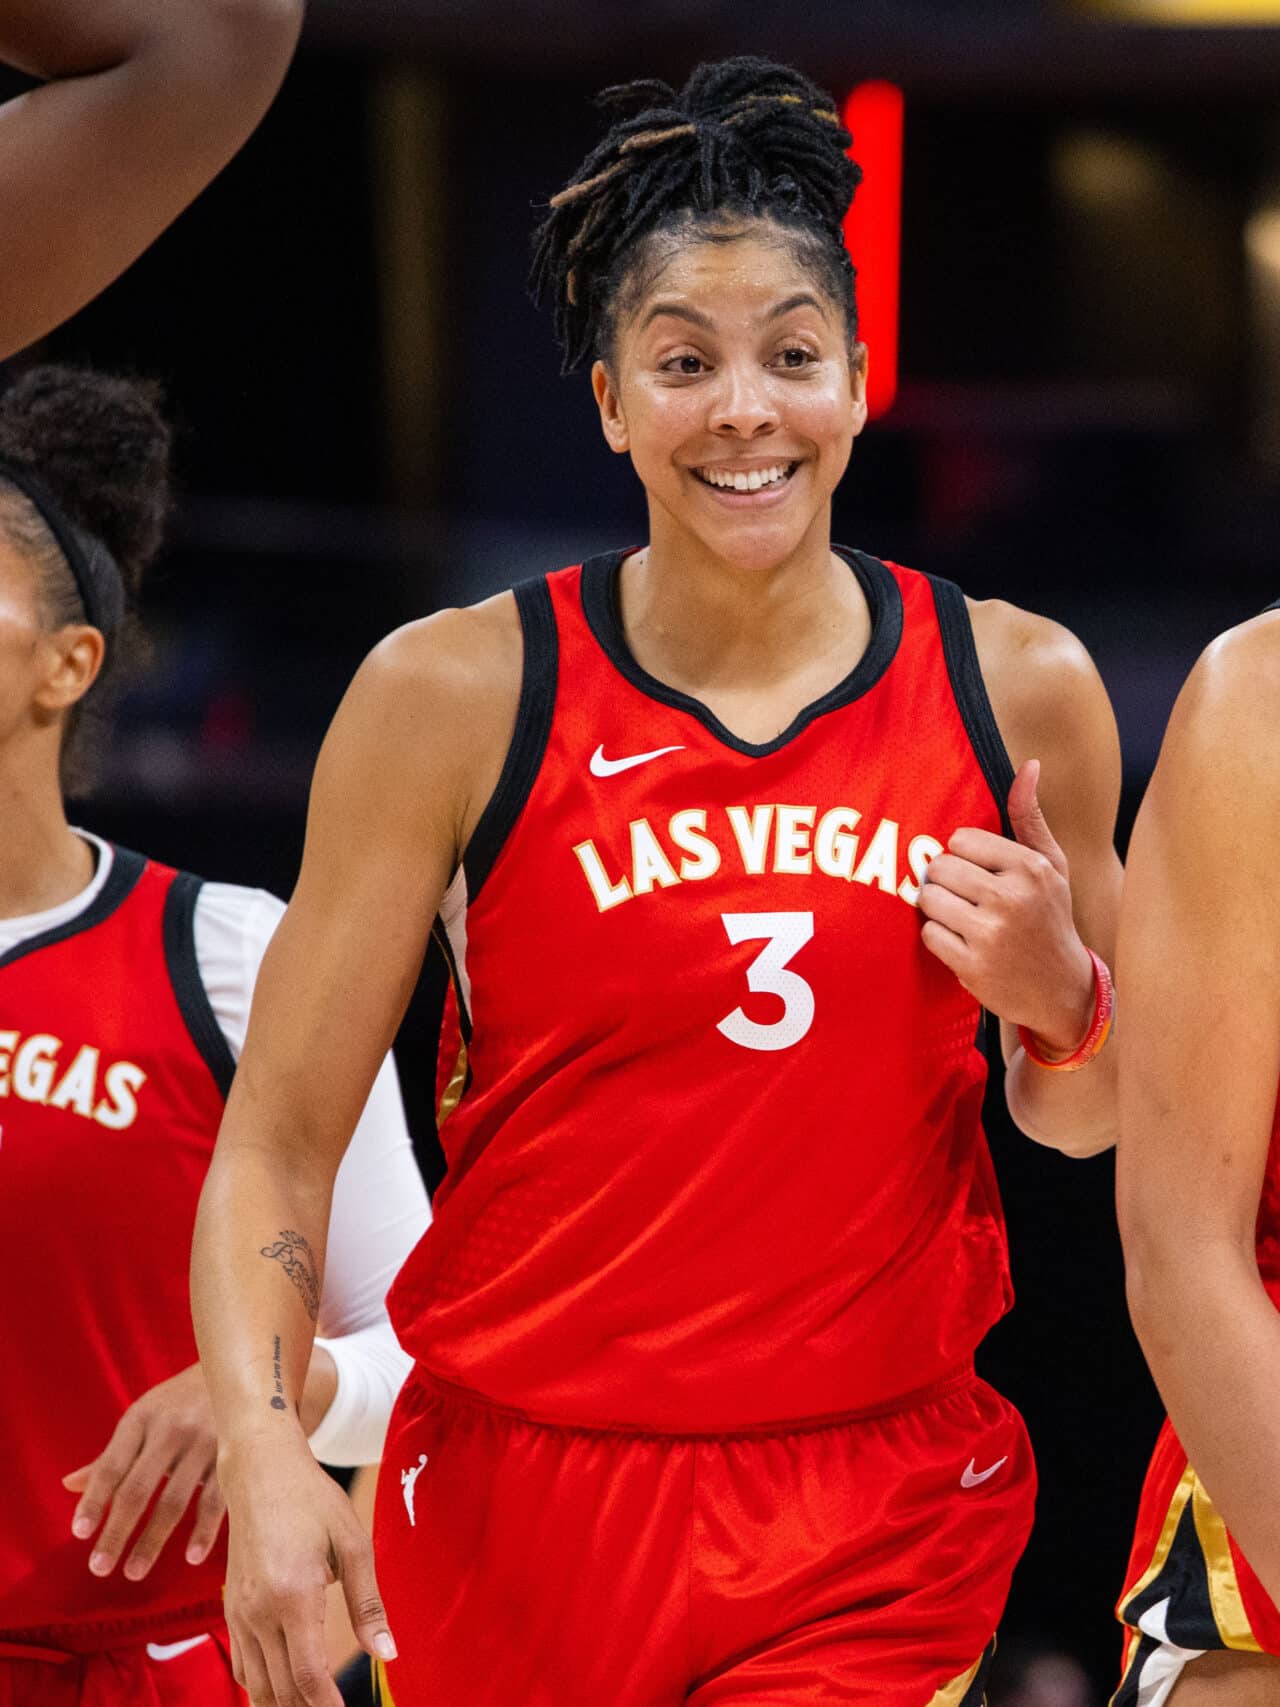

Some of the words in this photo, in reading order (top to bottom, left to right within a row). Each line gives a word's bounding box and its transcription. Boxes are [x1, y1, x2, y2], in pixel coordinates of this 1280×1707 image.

[572, 809, 721, 913] LAS
[726, 804, 944, 908] VEGAS
[715, 911, 816, 1051] 3
